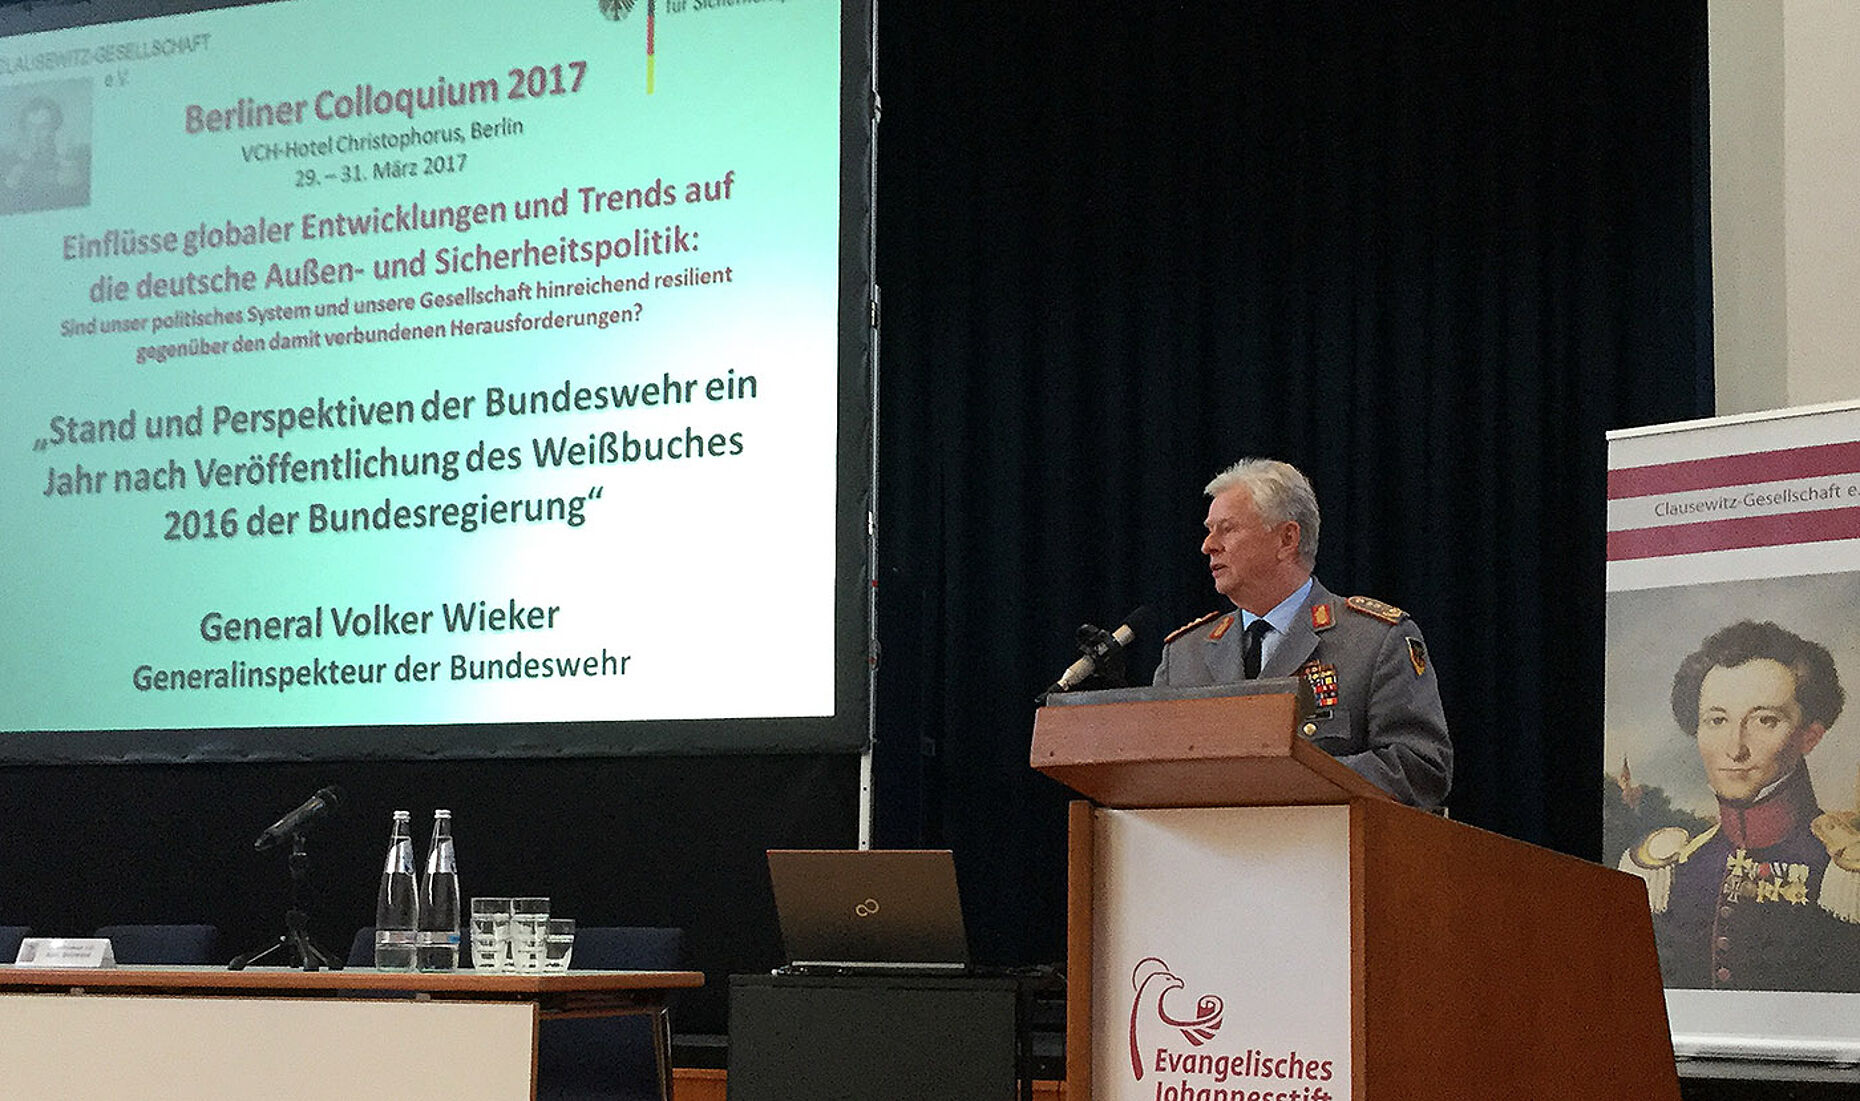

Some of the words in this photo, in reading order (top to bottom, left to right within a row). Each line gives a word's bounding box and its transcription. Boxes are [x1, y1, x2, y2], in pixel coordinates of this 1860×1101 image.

[186, 97, 308, 134] Berliner
[314, 76, 499, 121] Colloquium
[507, 60, 588, 100] 2017
[242, 136, 333, 162] VCH-Hotel
[336, 126, 465, 153] Christophorus,
[471, 117, 523, 140] Berlin
[295, 169, 321, 187] 29.
[341, 164, 367, 183] 31.
[373, 161, 417, 179] März
[423, 153, 468, 176] 2017
[64, 229, 178, 260] Einflüsse
[183, 217, 295, 257] globaler
[302, 202, 506, 240] Entwicklungen
[515, 187, 568, 220] und
[578, 178, 676, 214] Trends
[685, 170, 736, 204] auf
[90, 275, 129, 303] die
[136, 265, 257, 299] deutsche
[265, 258, 365, 289] Außen-
[374, 248, 426, 281] und
[435, 225, 699, 275] Sicherheitspolitik:
[61, 317, 97, 337] Sind
[100, 318, 148, 333] unser
[152, 307, 243, 334] politisches
[247, 305, 311, 326] System
[314, 297, 349, 318] und
[354, 297, 416, 314] unsere
[420, 282, 532, 309] Gesellschaft
[536, 271, 649, 299] hinreichend
[655, 267, 733, 289] resilient
[136, 338, 229, 364] gegenüber
[232, 334, 265, 353] den
[269, 330, 321, 351] damit
[323, 322, 447, 346] verbundenen
[450, 303, 643, 337] Herausforderungen?
[32, 409, 136, 451] „Stand
[146, 405, 203, 440] und
[213, 396, 414, 439] Perspektiven
[421, 389, 476, 423] der
[486, 372, 698, 417] Bundeswehr
[705, 368, 757, 402] ein
[43, 464, 108, 497] Jahr
[113, 459, 186, 493] nach
[194, 446, 460, 489] Veröffentlichung
[466, 440, 522, 472] des
[532, 426, 744, 468] Weißbuches
[164, 508, 240, 541] 2016
[247, 504, 300, 538] der
[309, 486, 604, 534] Bundesregierung“
[1654, 483, 1841, 517] Clausewitz-Gesellschaft
[200, 606, 323, 643] General
[331, 603, 434, 638] Volker
[442, 598, 560, 633] Wieker
[133, 657, 387, 693] Generalinspekteur
[394, 654, 441, 683] der
[451, 648, 631, 681] Bundeswehr
[1155, 1048, 1333, 1083] Evangelisches
